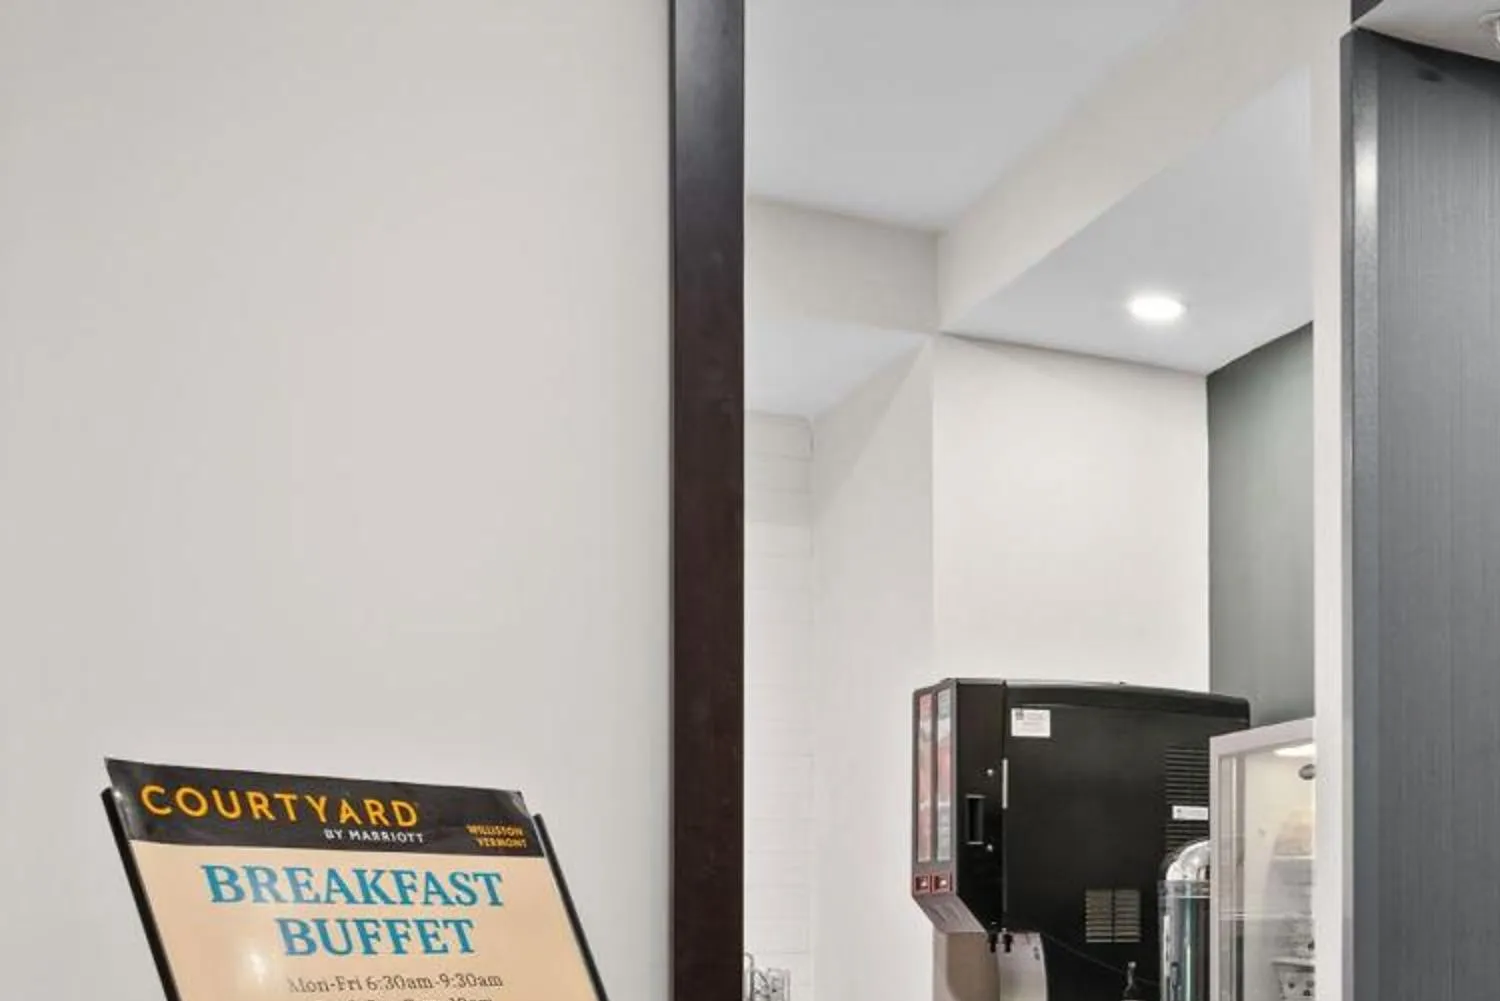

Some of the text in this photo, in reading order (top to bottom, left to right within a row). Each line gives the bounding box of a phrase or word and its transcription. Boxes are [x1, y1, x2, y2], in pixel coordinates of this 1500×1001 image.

[141, 784, 418, 827] COURTYARD
[324, 828, 424, 843] BY MARRIOTT
[201, 863, 504, 907] BREAKFAST
[275, 917, 475, 956] BUFFET
